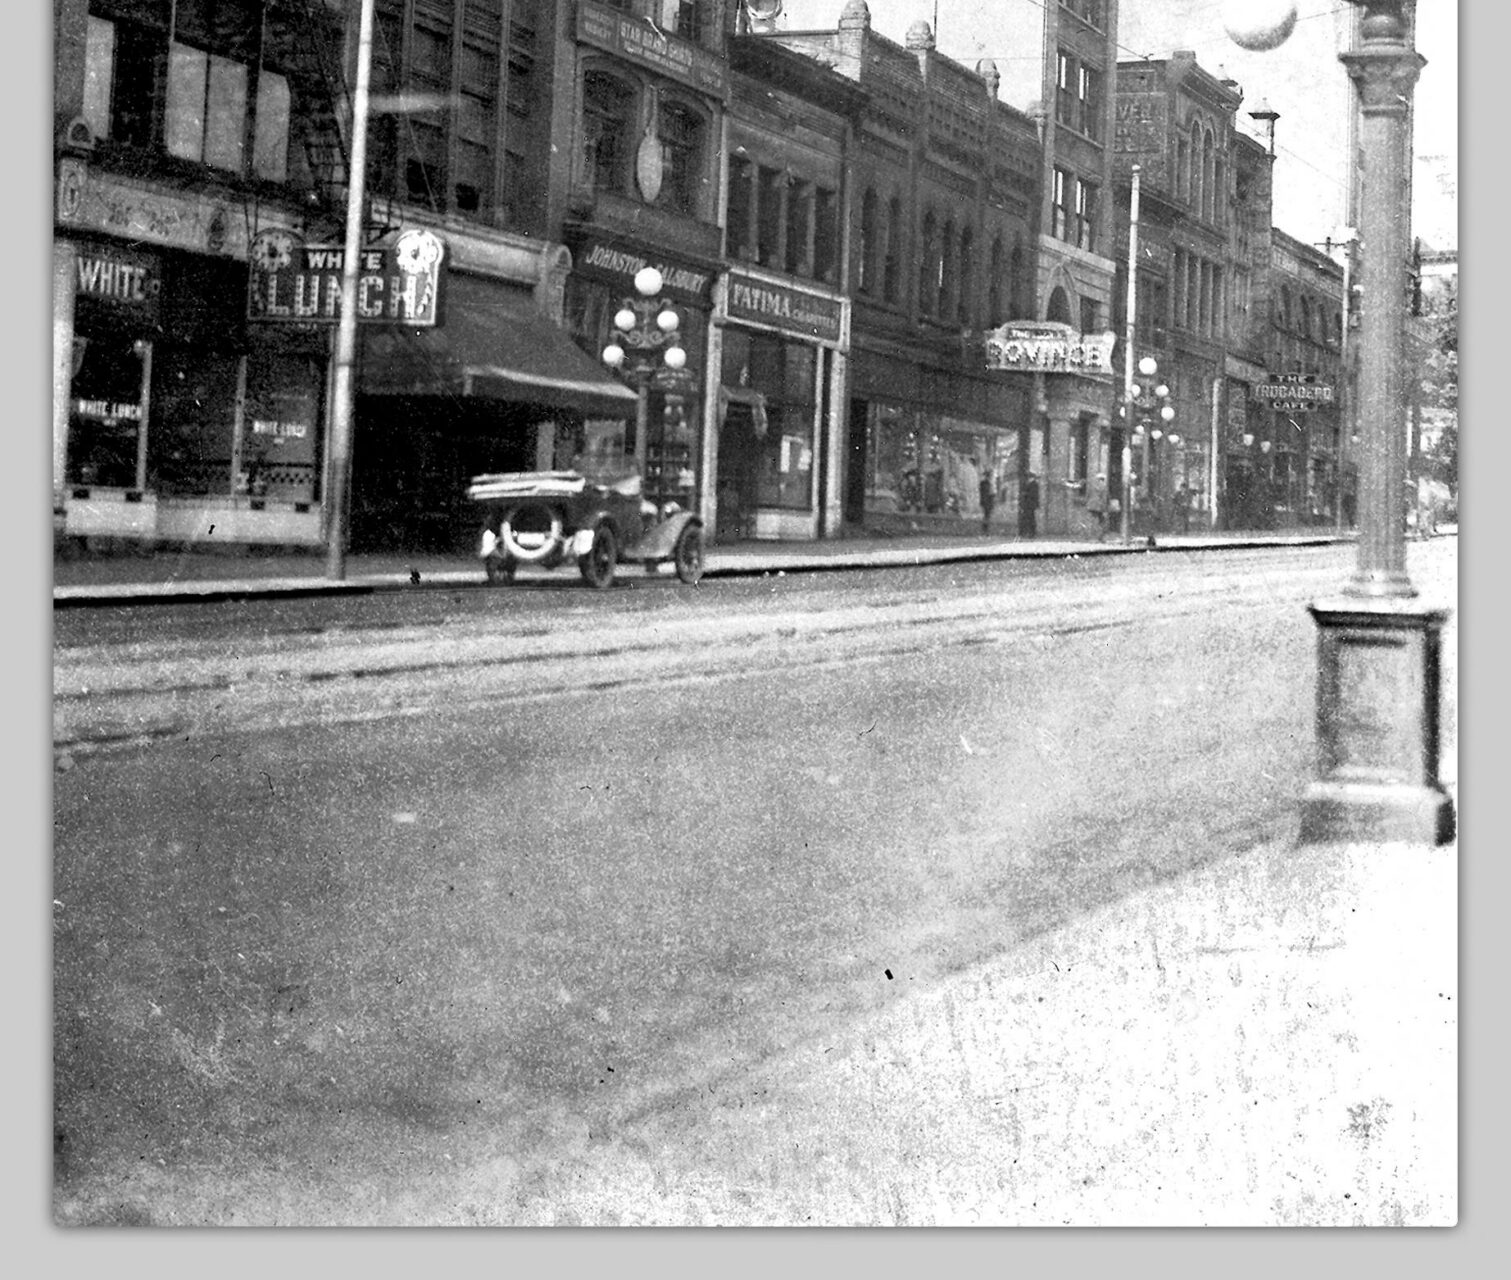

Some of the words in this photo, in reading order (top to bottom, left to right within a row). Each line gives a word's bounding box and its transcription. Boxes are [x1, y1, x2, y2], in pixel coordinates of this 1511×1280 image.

[307, 251, 383, 270] WHE
[77, 256, 147, 301] WHITE
[267, 274, 418, 319] LUNCH
[733, 283, 792, 319] FATIMA
[988, 339, 1103, 368] ROVINCE
[1276, 375, 1308, 384] THE
[79, 399, 108, 418] WHITE
[110, 401, 143, 420] LUNCH
